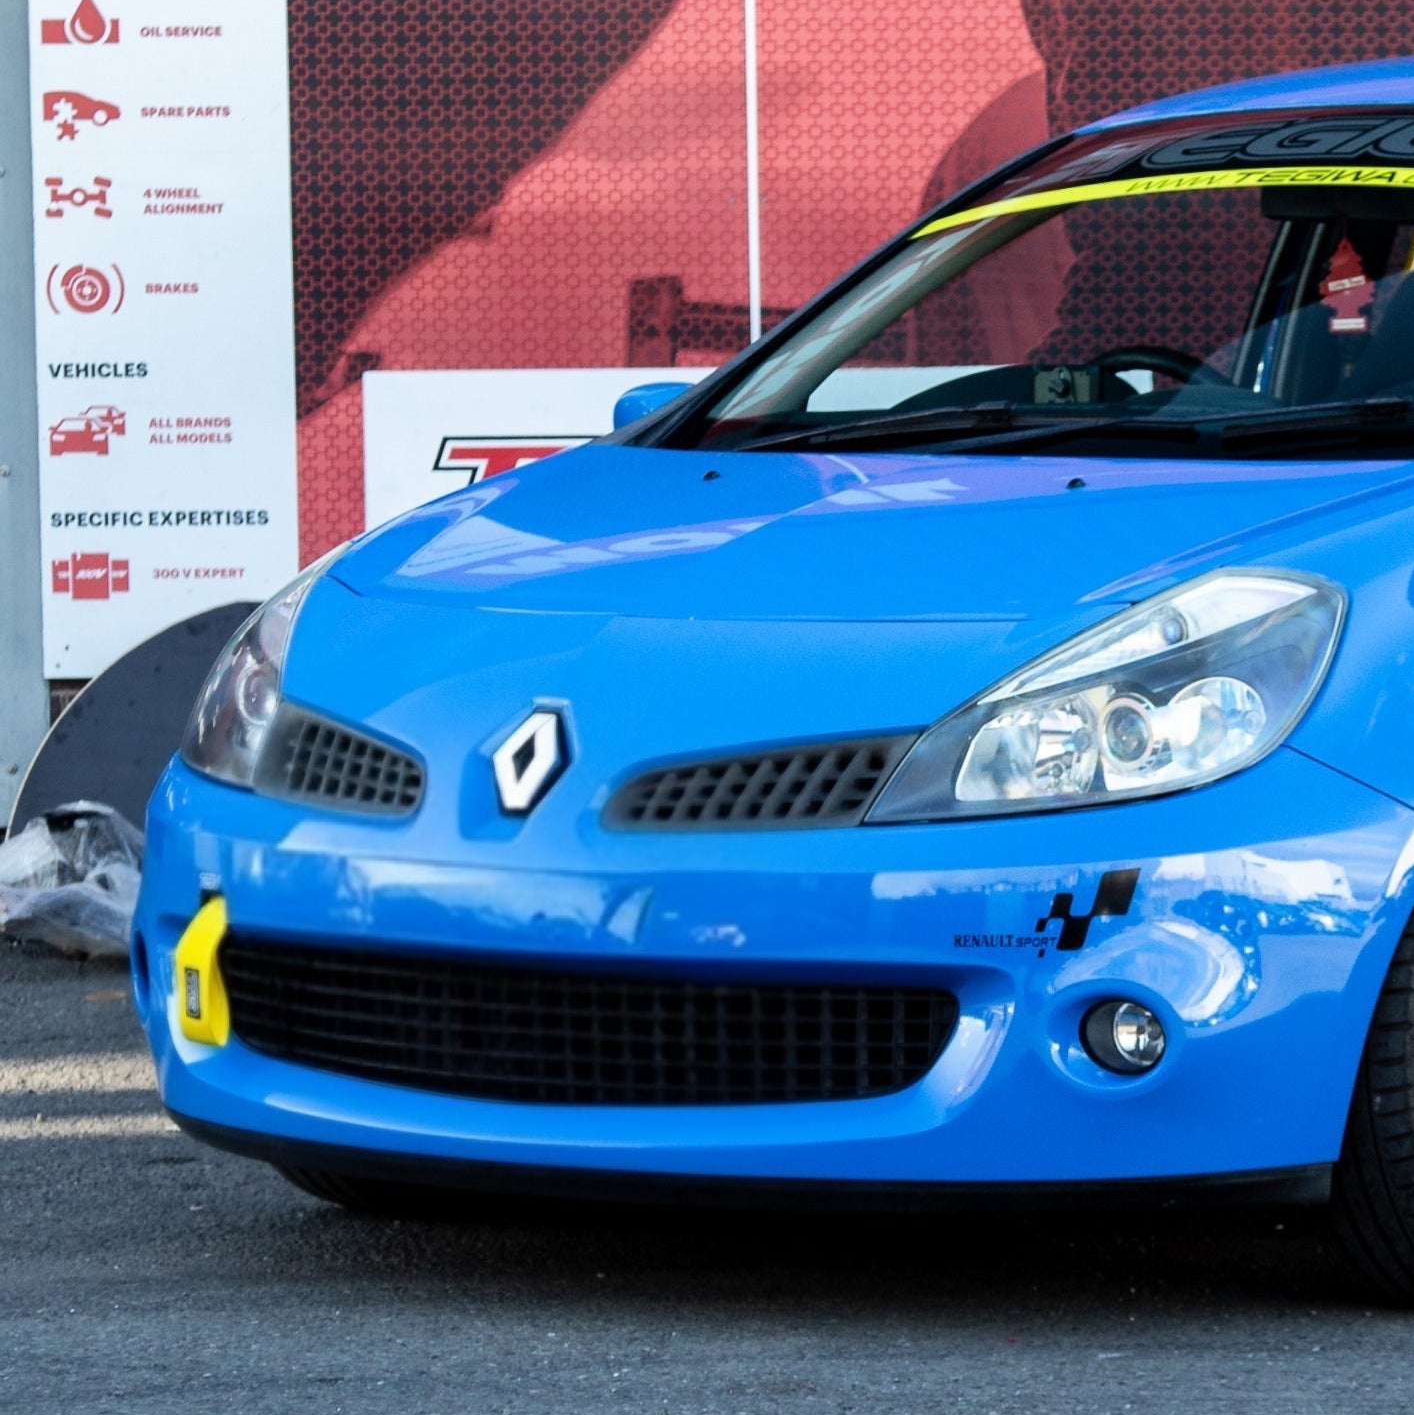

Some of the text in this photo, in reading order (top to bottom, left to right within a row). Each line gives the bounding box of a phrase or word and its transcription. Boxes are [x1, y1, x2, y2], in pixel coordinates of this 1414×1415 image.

[139, 25, 223, 38] OIL SERVICE
[140, 105, 231, 119] SPARE PARTS
[153, 187, 201, 200] WHEEL
[143, 202, 224, 215] ALIGNMENT
[145, 282, 200, 294] BRAKES
[47, 361, 149, 379] VEHICLES
[148, 416, 232, 429] ALL BRANDS
[148, 432, 233, 445] ALL MODELS
[50, 509, 270, 529] SPECIFIC EXPERTISES
[153, 567, 245, 580] 300 V EXPERT
[953, 934, 1058, 948] RENAULT SPORT
